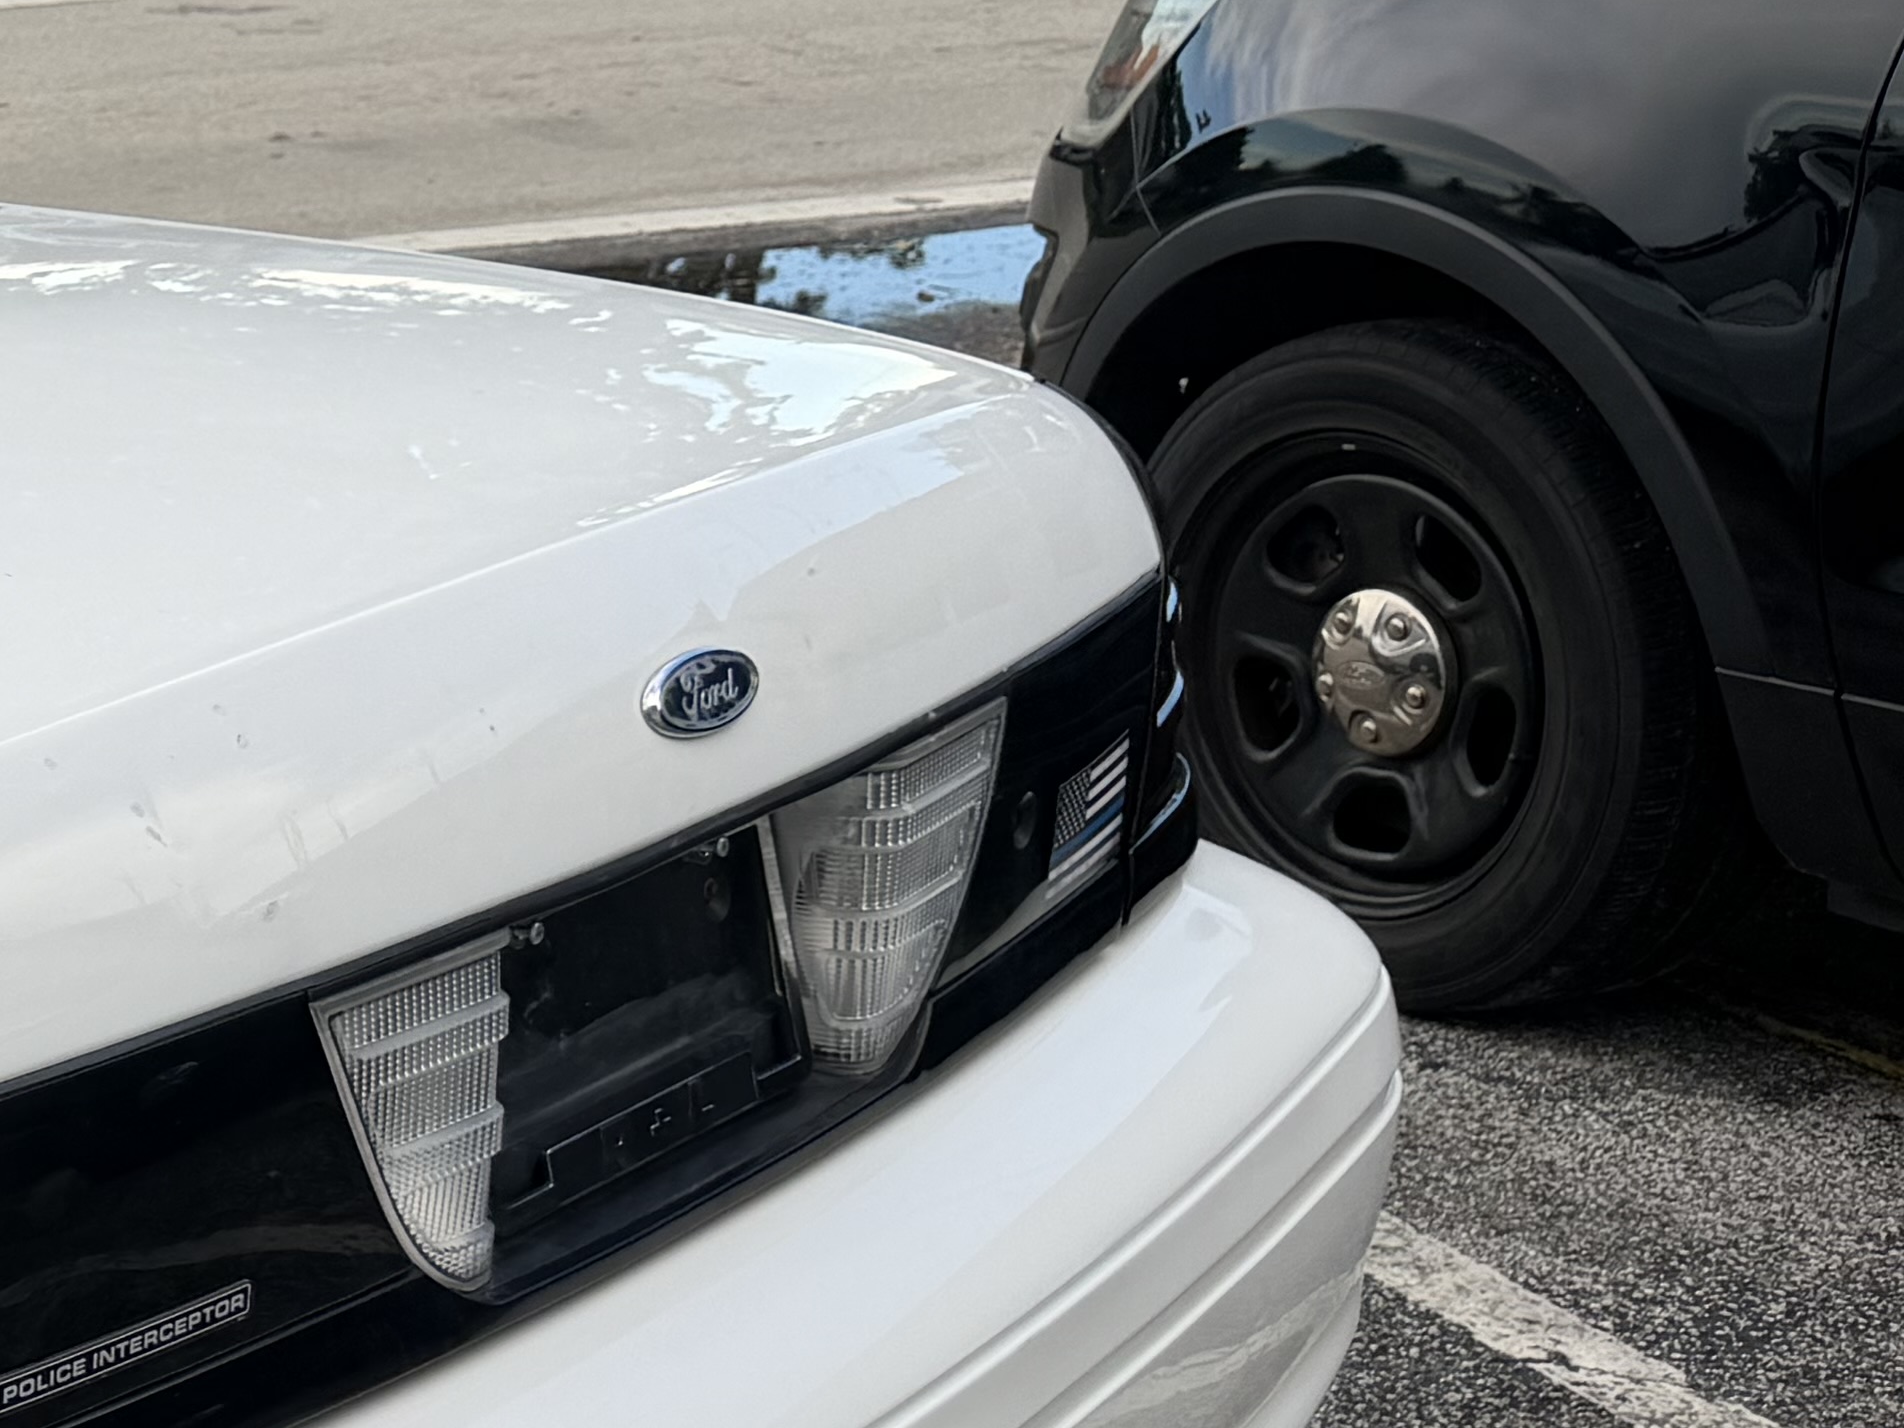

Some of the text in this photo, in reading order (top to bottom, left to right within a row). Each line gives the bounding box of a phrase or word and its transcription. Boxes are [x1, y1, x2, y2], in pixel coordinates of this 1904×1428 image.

[680, 659, 740, 722] Ford
[2, 1293, 245, 1404] POLICE INTERCEPTOR
